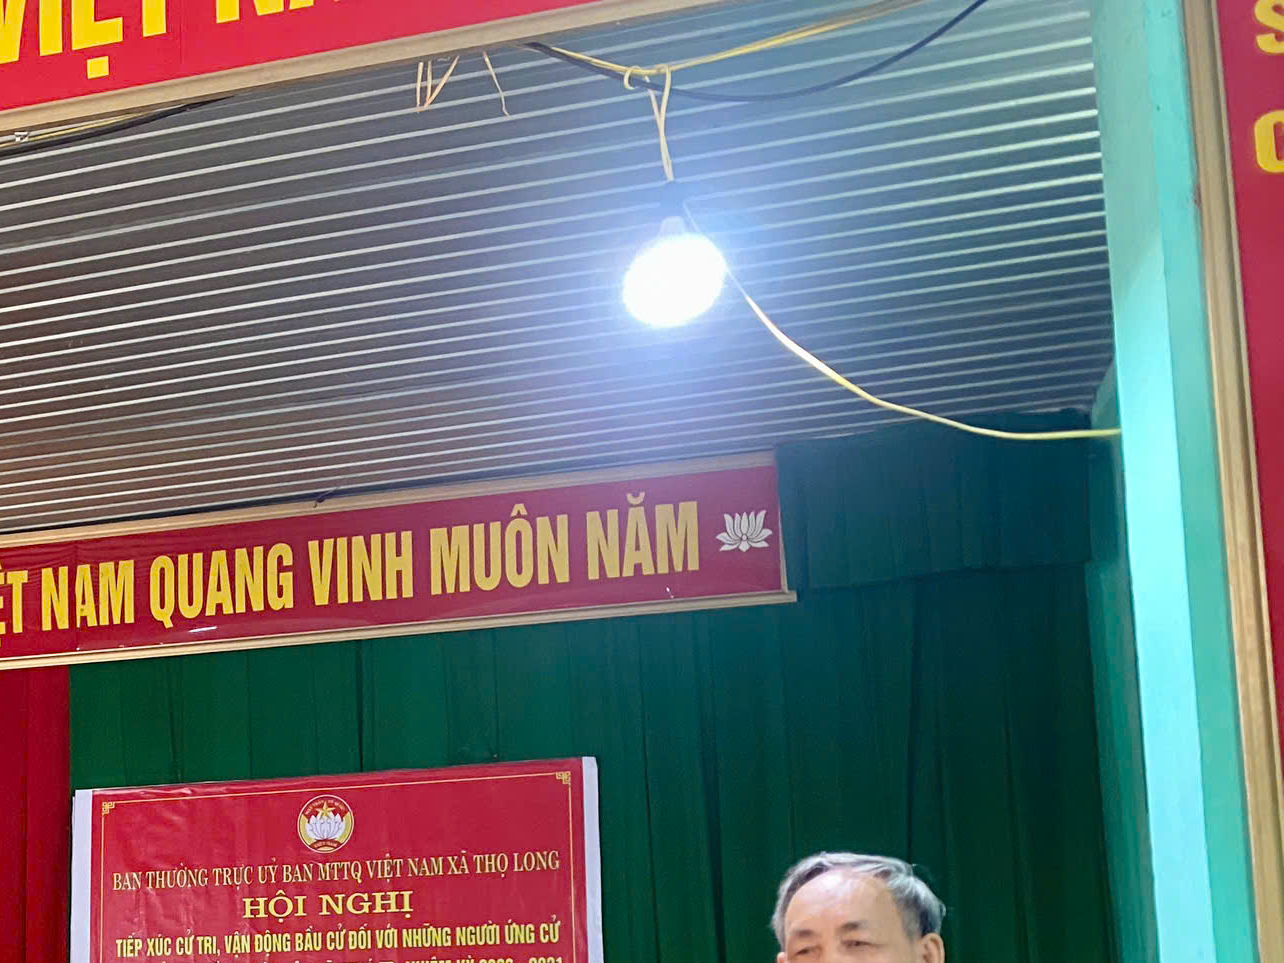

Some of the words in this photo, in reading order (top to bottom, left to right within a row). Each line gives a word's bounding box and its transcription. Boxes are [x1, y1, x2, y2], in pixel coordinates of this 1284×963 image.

[41, 559, 135, 632] NAM
[149, 542, 294, 629] QUANG
[307, 530, 414, 607] VINH
[429, 502, 570, 596] MUÔN
[586, 491, 700, 580] NĂM
[113, 871, 142, 890] BAN
[146, 863, 209, 889] THƯỜNG
[213, 865, 253, 890] TRỰC
[257, 857, 278, 884] UỶ
[282, 863, 314, 883] BAN
[317, 861, 362, 883] MTTQ
[366, 853, 403, 882] VIỆT
[407, 857, 444, 877] NAM
[447, 850, 469, 875] XÃ
[473, 853, 509, 878] THỌ
[513, 850, 560, 872] LONG
[242, 889, 307, 923] HỘI
[318, 891, 414, 919] NGHỊ
[116, 932, 143, 957] TIẾP
[146, 933, 172, 957] XÚC
[175, 928, 194, 955] CỬ
[197, 936, 220, 957] TRI,
[224, 931, 250, 958] VẬN
[254, 930, 291, 957] ĐỘNG
[295, 925, 324, 951] BẦU
[326, 923, 346, 950] CỬ
[348, 923, 371, 949] ĐỐI
[375, 923, 398, 949] VỚI
[402, 923, 451, 948] NHỮNG
[455, 921, 500, 946] NGƯỜI
[504, 919, 535, 944] ỨNG
[539, 914, 561, 943] CỬ
